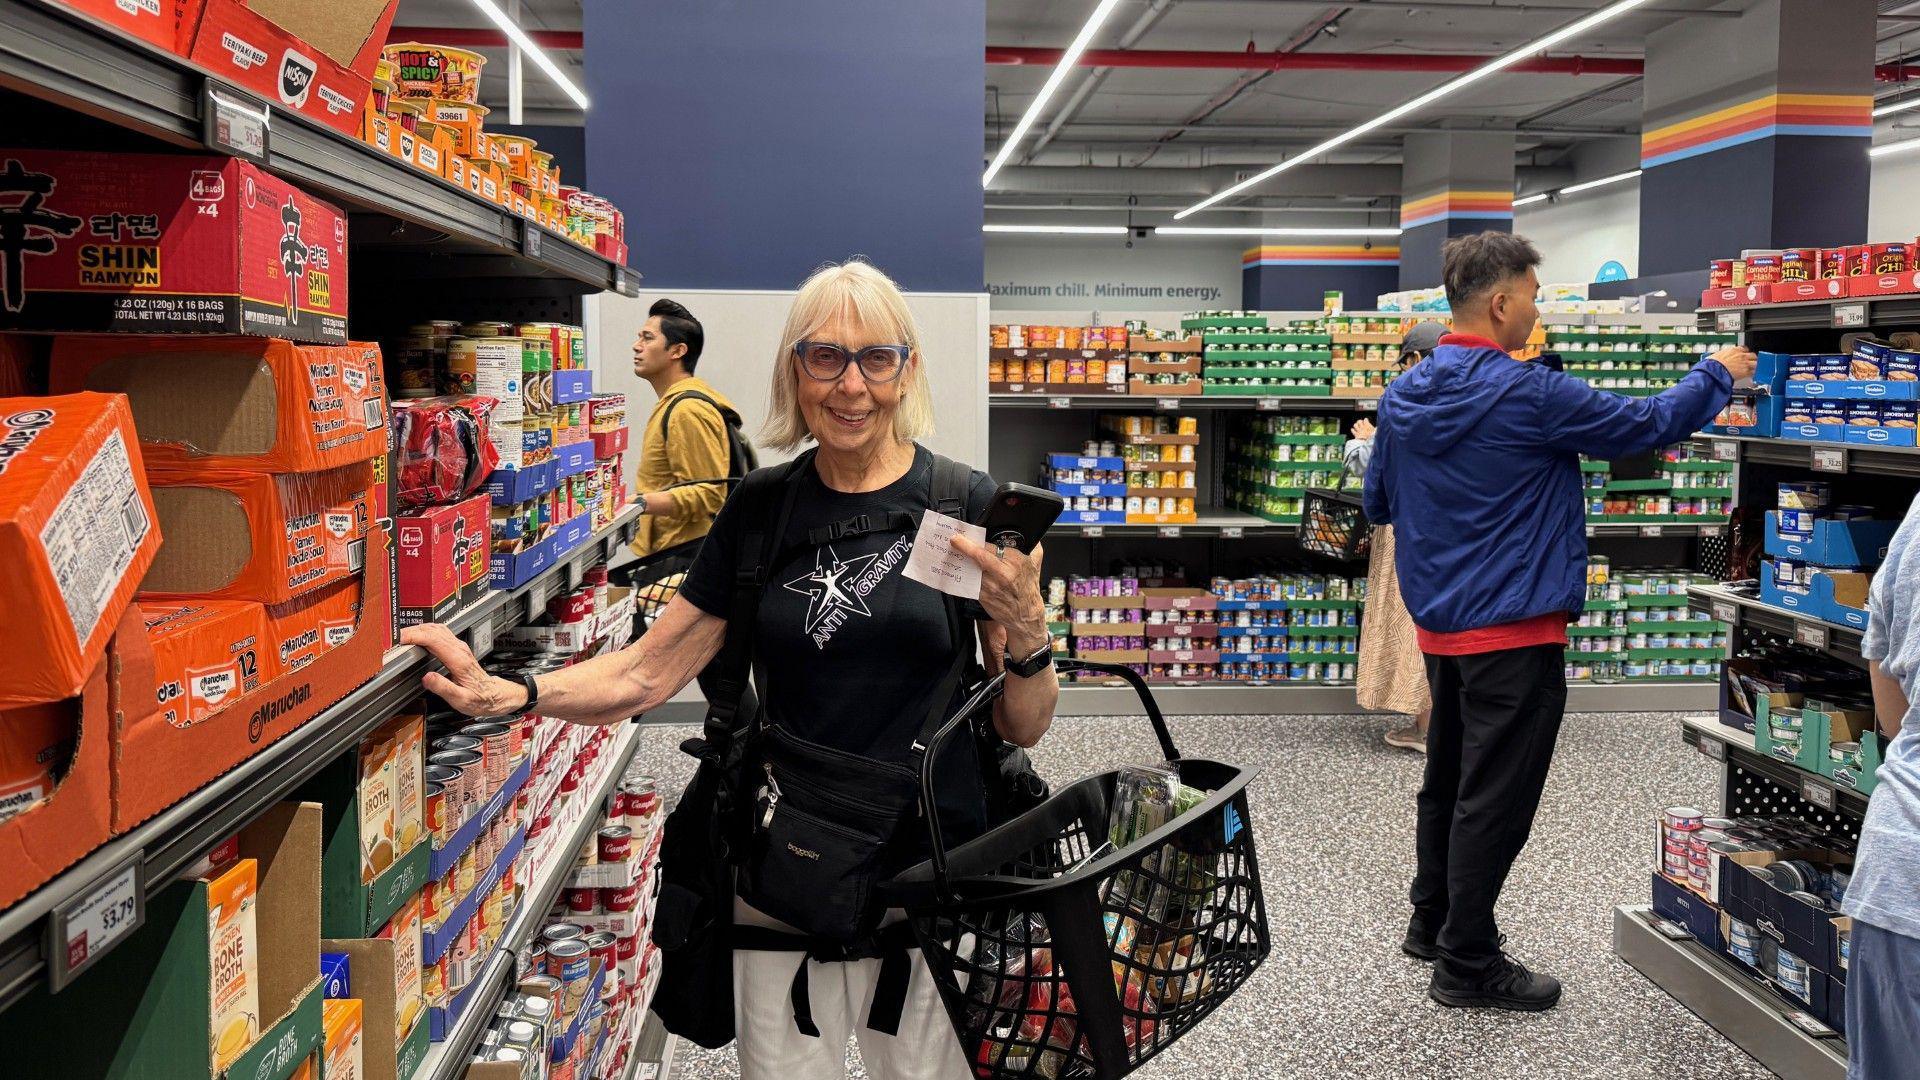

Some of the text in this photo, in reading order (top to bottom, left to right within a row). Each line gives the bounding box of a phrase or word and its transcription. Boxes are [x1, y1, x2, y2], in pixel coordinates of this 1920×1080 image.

[224, 37, 266, 64] TERIYAKI BEEF
[400, 52, 438, 67] HOT &
[284, 65, 308, 87] NISSIN
[402, 66, 438, 80] SPICY
[193, 180, 222, 196] 4 BAGS
[198, 204, 218, 218] x4
[90, 212, 161, 242] 라면
[80, 246, 158, 268] SHIN
[82, 270, 158, 284] RAMYUN
[1714, 270, 1728, 278] Beef
[1747, 266, 1770, 274] Corned
[1754, 273, 1773, 281] Hash
[308, 270, 330, 294] SHIN
[984, 282, 1221, 300] Maximum chill. Minimum energy.
[114, 300, 224, 310] 4.23 OZ (120g) X 16 BAGS
[309, 292, 330, 307] RAMYUN
[114, 311, 224, 324] TOTAL NET WT 4.23 LBS (1.92kg)
[1850, 314, 1863, 322] $1.99
[368, 361, 381, 382] 12
[356, 502, 367, 523] 12
[295, 535, 315, 549] Ramen
[404, 534, 410, 544] 4
[288, 545, 324, 568] Noodle Soup
[406, 549, 419, 558] x4
[812, 607, 848, 650] ANTI
[286, 629, 319, 654] Maruchan
[237, 651, 258, 678] 12
[290, 653, 314, 669] Ramen
[201, 670, 230, 690] Maruchan
[102, 896, 134, 930] $3.79
[214, 926, 241, 954] CHICKEN
[214, 936, 243, 975] BONE
[396, 943, 415, 970] BONE
[215, 962, 243, 993] BROTH
[278, 1026, 296, 1055] BONE
[276, 1042, 298, 1073] BROTH
